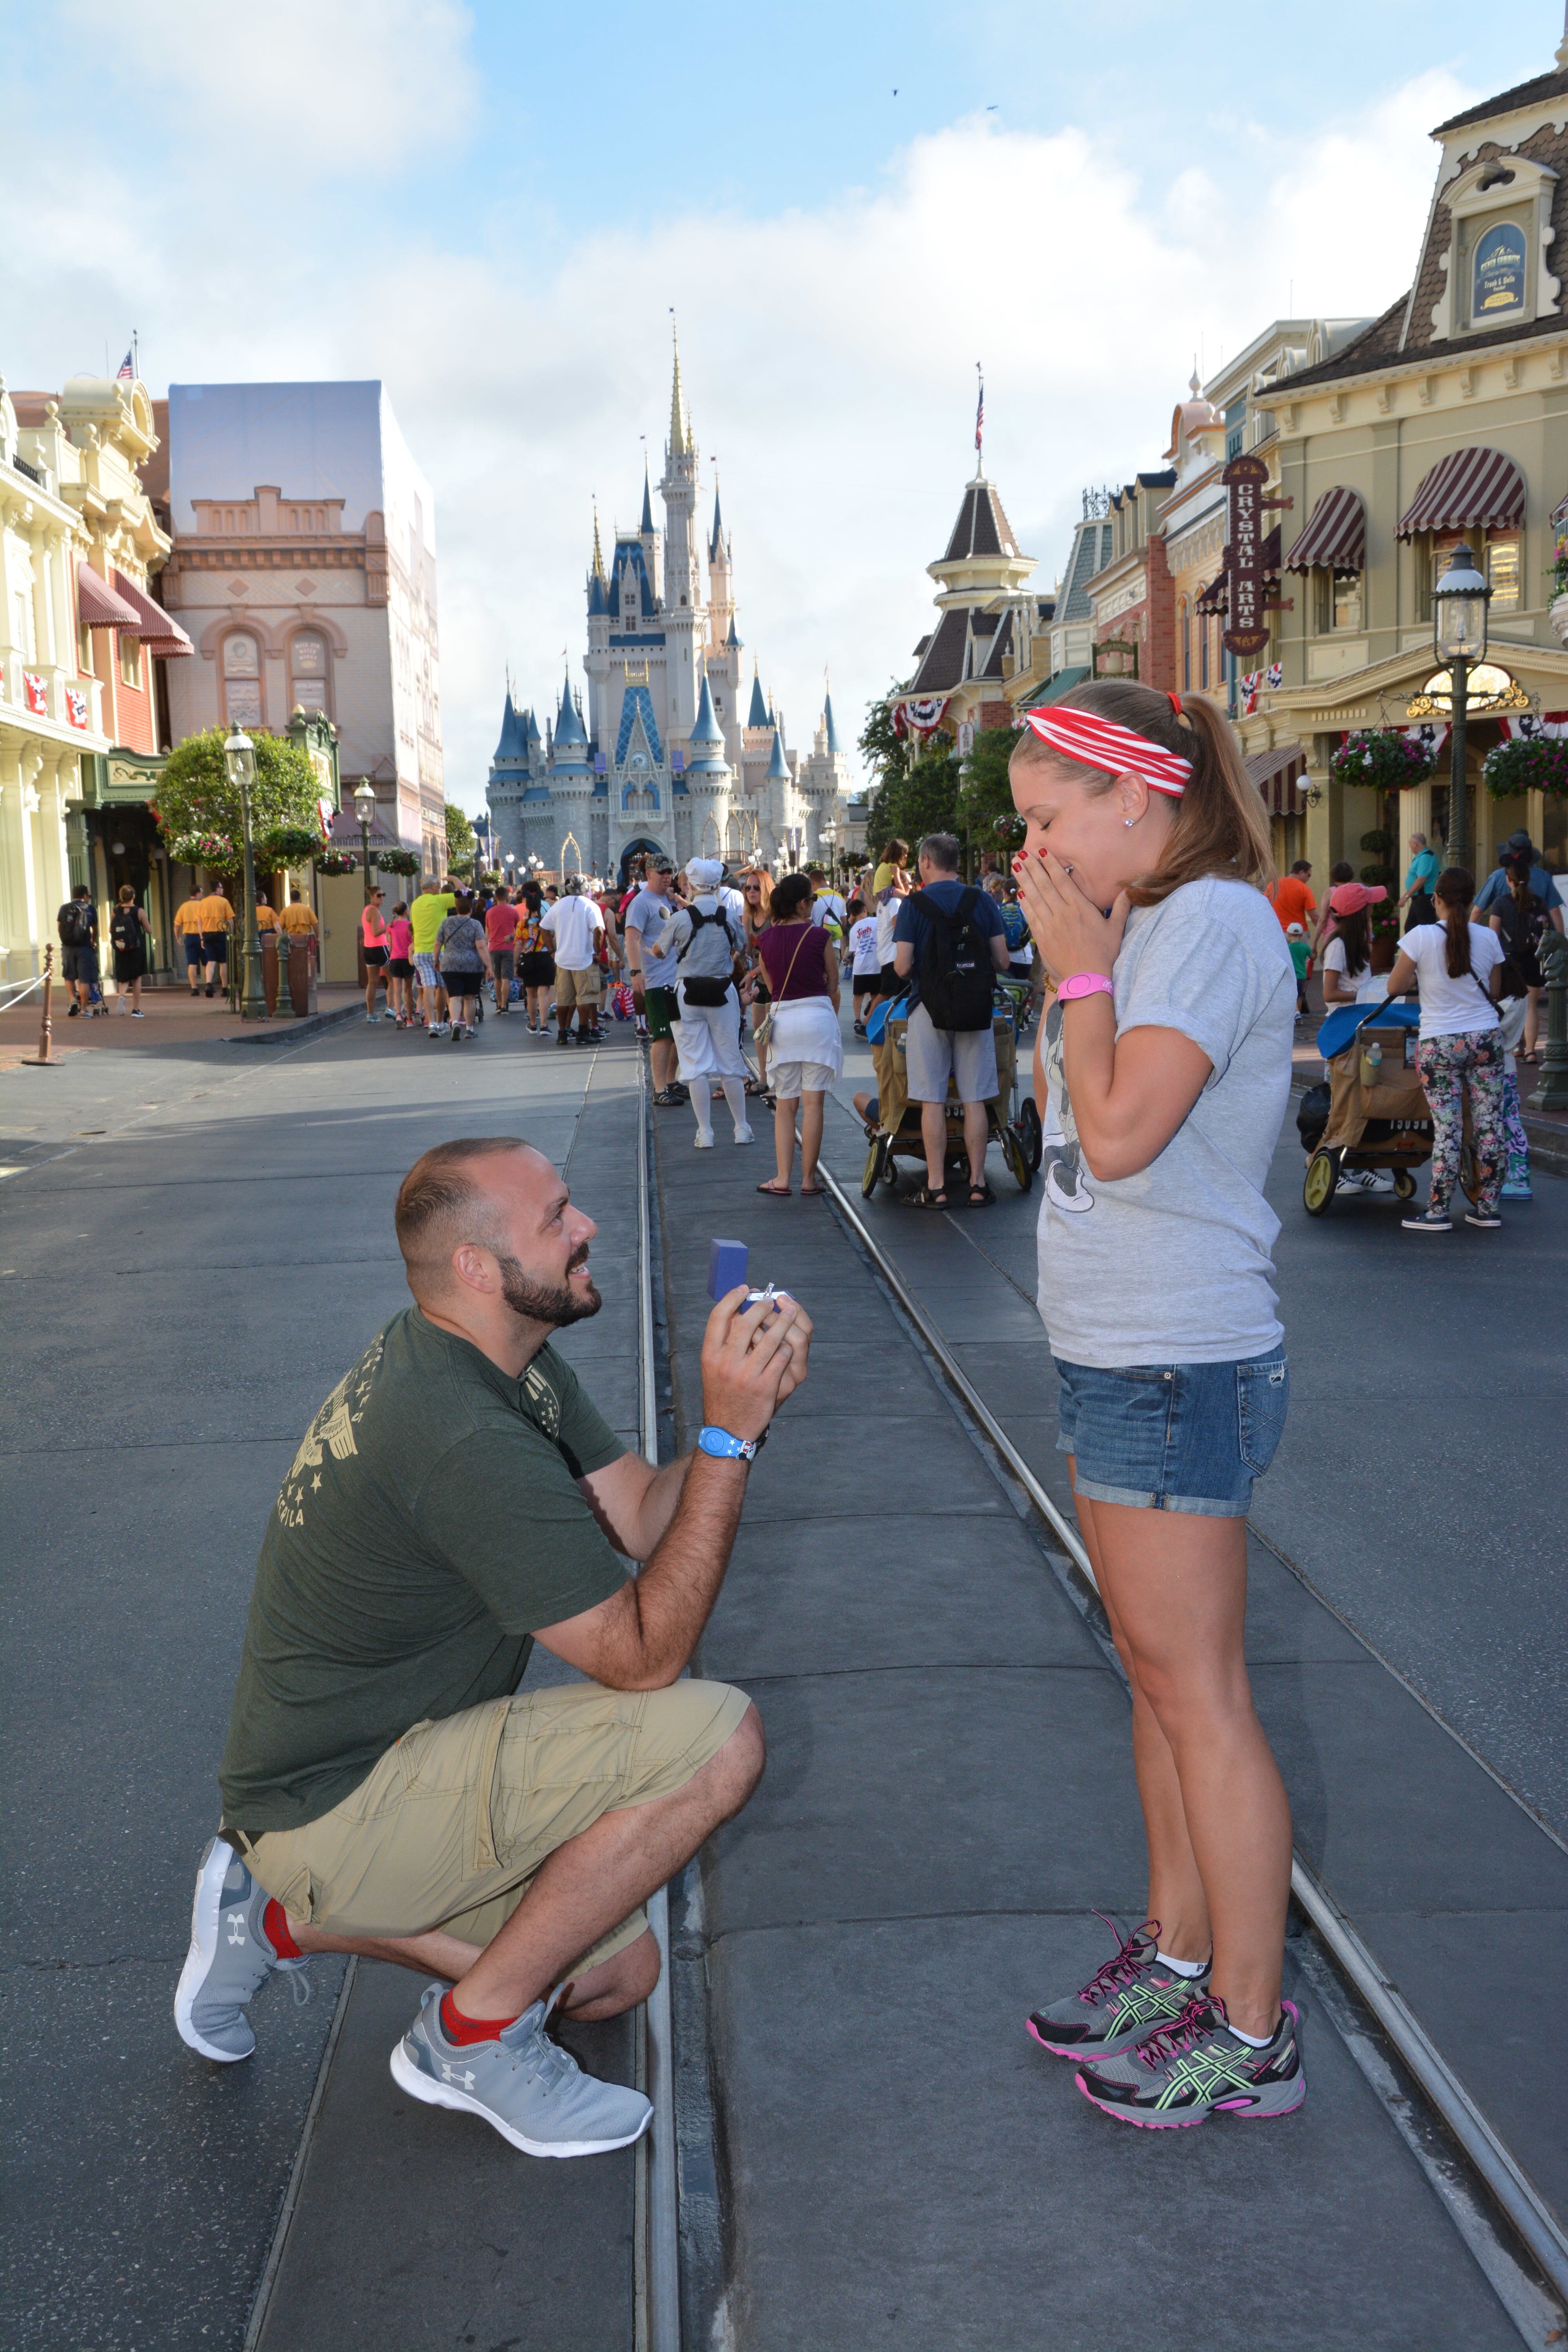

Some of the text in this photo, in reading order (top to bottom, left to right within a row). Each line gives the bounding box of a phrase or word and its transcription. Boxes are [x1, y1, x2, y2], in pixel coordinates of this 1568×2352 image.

[1485, 279, 1497, 289] Frank
[1503, 275, 1515, 284] Wells
[1238, 484, 1254, 568] CRYSTAL
[1238, 581, 1254, 628] ARTS
